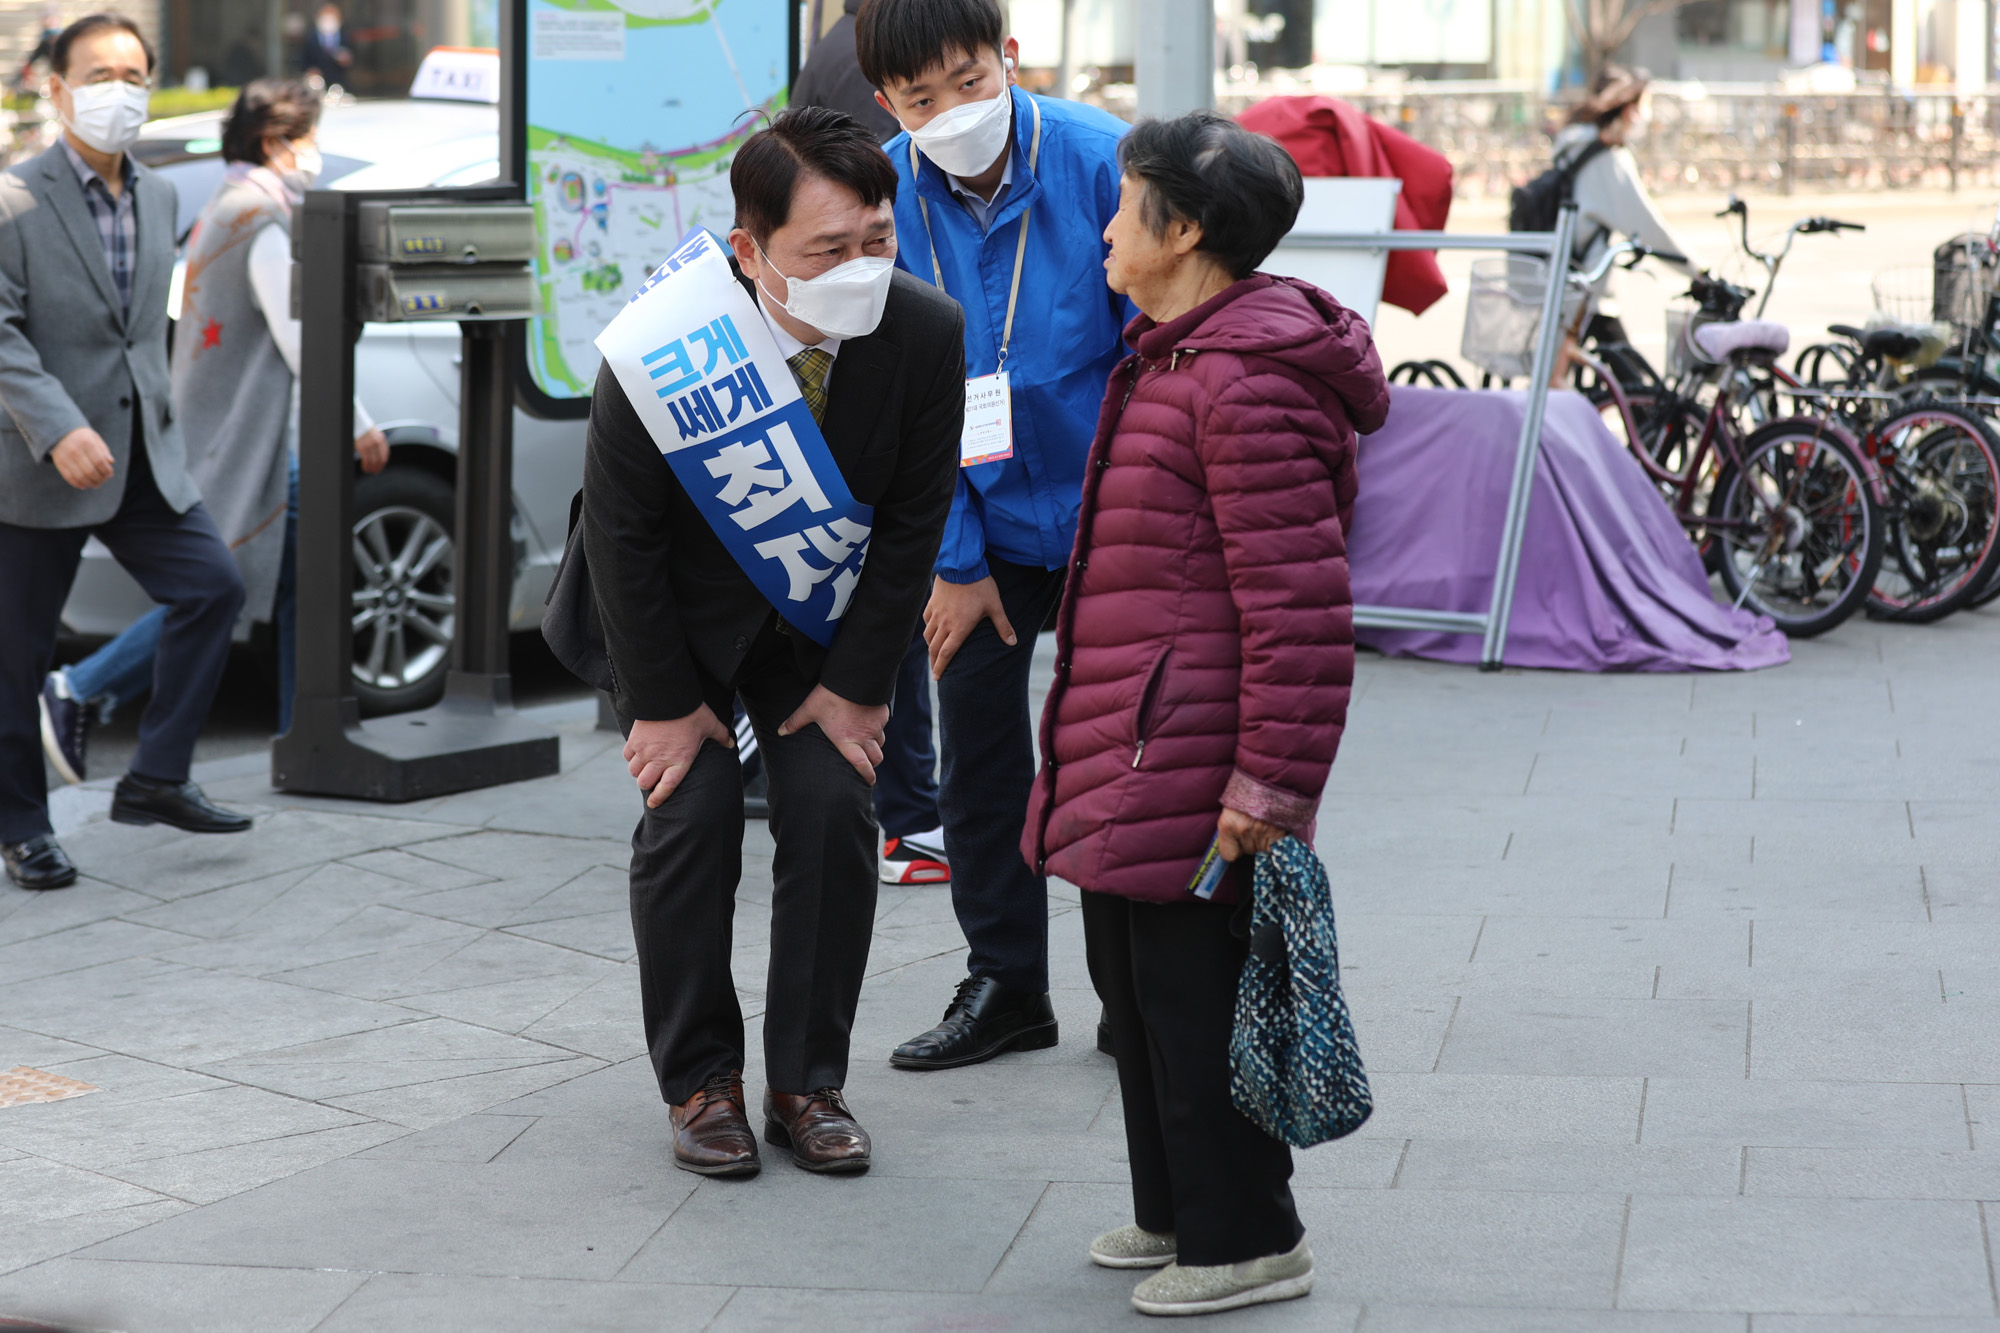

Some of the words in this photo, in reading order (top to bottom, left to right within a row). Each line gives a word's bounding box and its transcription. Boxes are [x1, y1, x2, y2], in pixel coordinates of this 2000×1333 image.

[432, 69, 482, 91] TAXI
[641, 313, 750, 399] 크게
[667, 361, 774, 441] 쎄게
